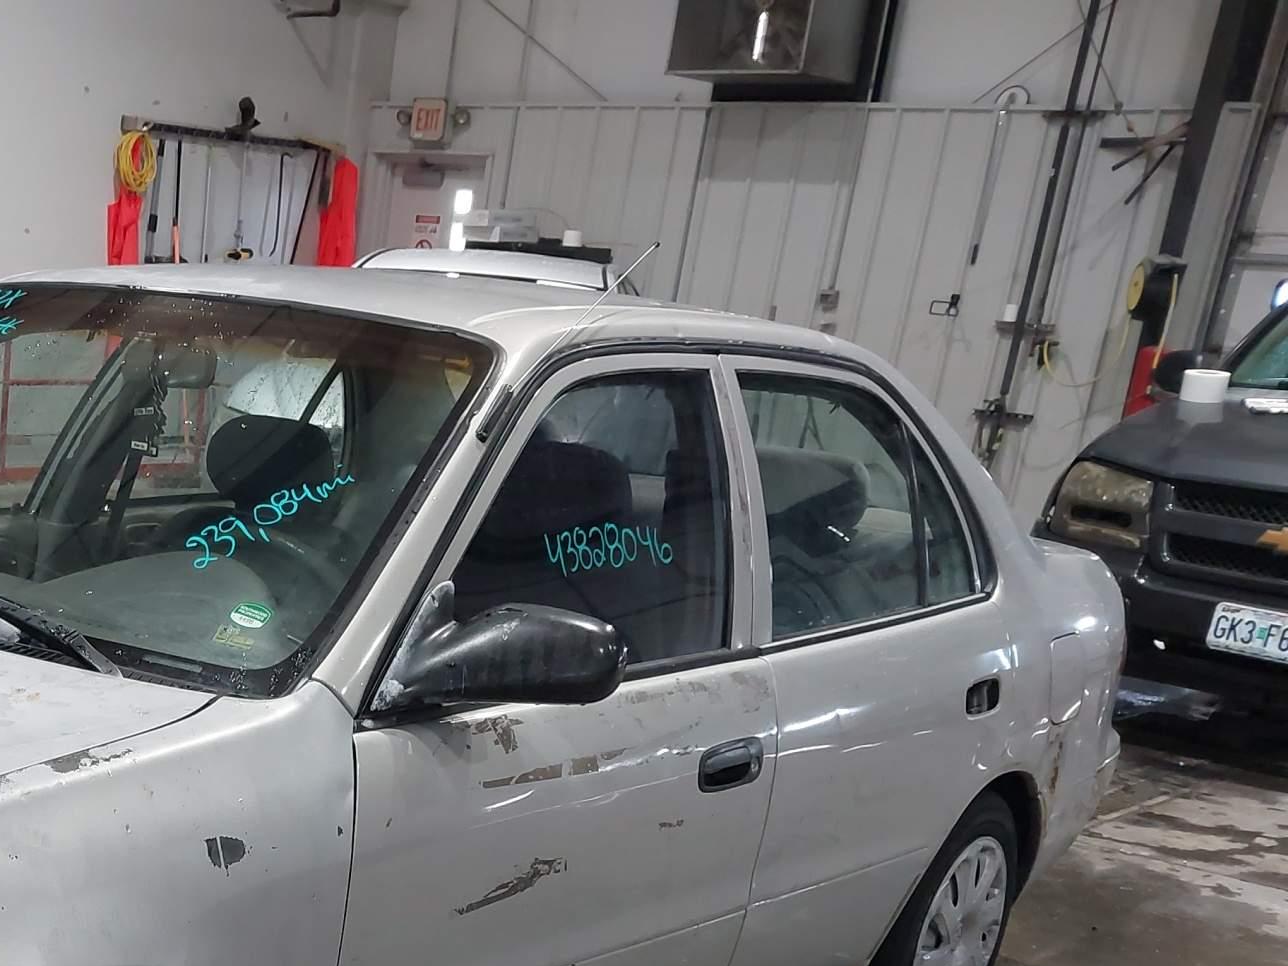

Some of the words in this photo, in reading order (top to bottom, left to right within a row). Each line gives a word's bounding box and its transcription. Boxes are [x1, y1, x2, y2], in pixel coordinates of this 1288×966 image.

[416, 108, 440, 131] EXIT
[543, 522, 673, 577] 43828046
[1213, 614, 1257, 645] GK3
